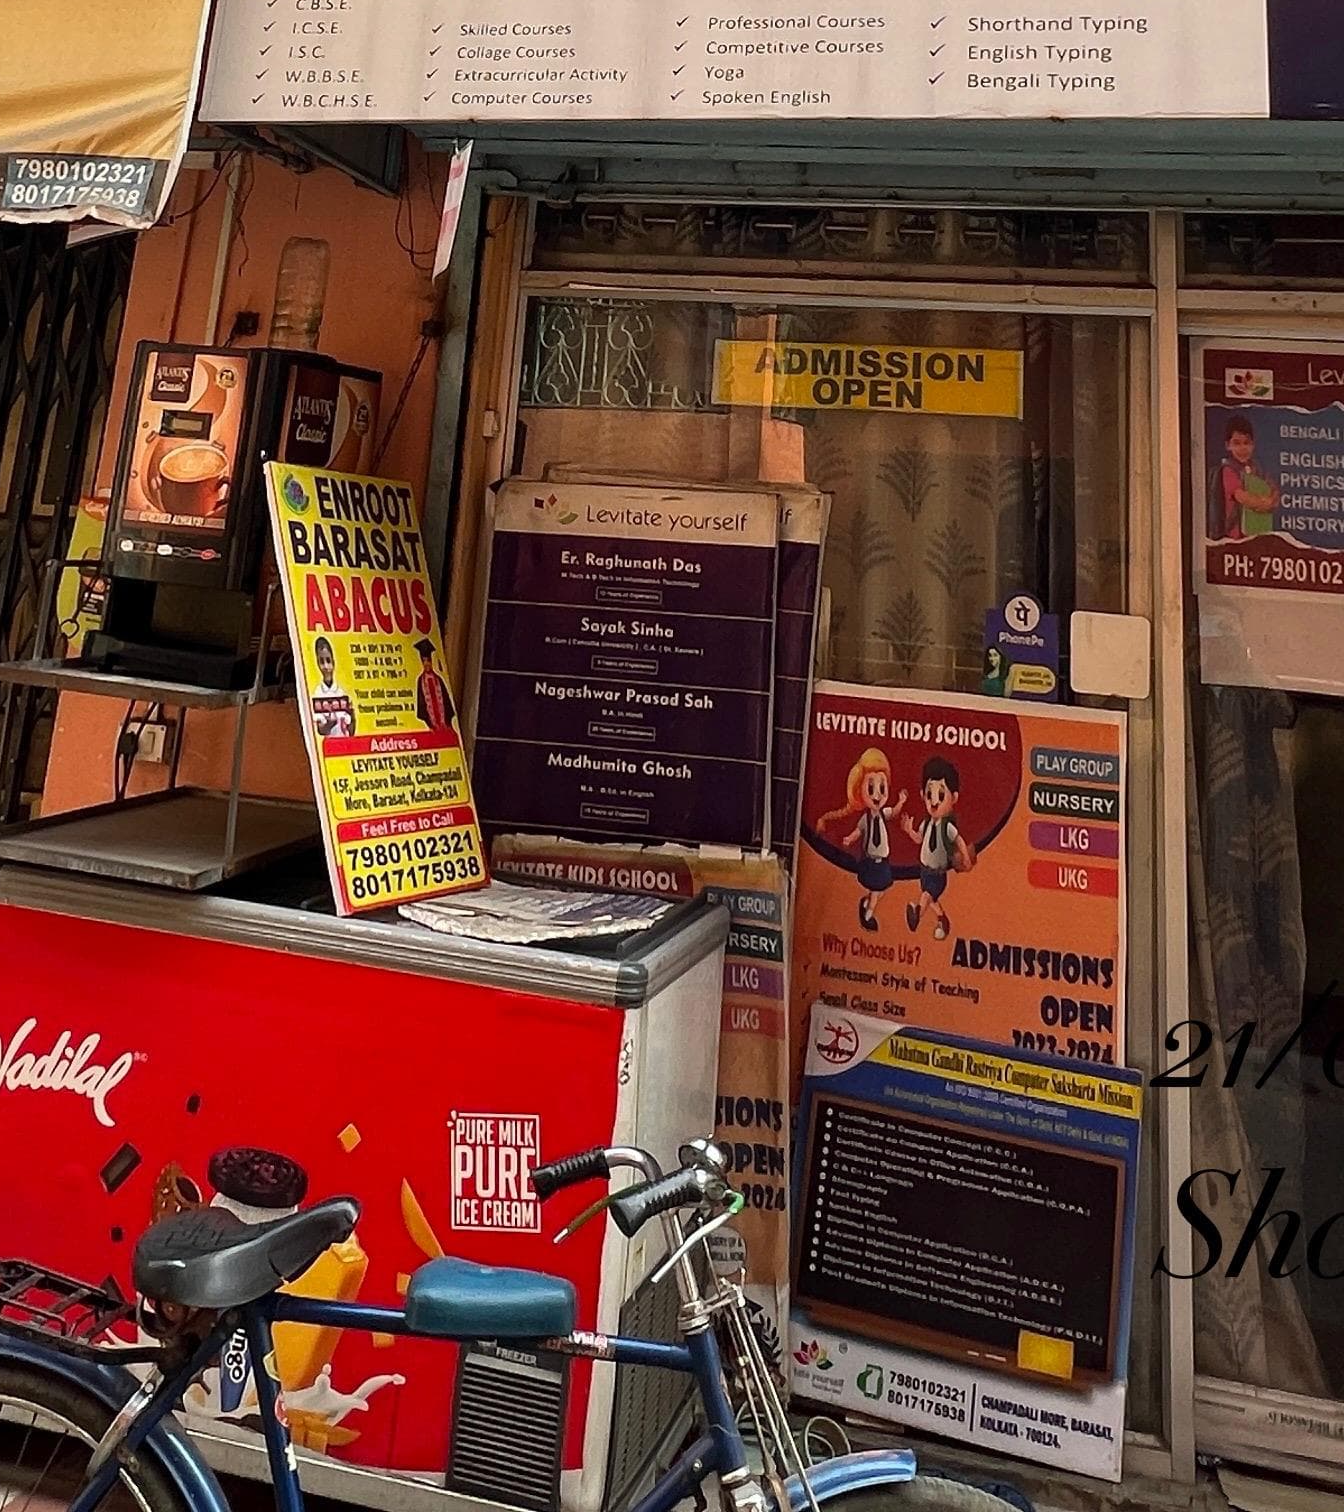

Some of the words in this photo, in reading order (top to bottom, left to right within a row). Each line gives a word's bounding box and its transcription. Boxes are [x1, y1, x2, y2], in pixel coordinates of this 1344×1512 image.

[460, 23, 508, 36] Skilled
[512, 23, 572, 35] Courses
[708, 16, 811, 31] Professional
[816, 14, 886, 30] Courses
[968, 16, 1072, 32] Shorthand
[1080, 16, 1148, 34] Typing
[457, 46, 511, 60] Collage
[516, 46, 576, 59] Courses
[706, 39, 810, 58] Competitive
[814, 40, 884, 54] Courses
[968, 45, 1038, 62] English
[1044, 46, 1112, 63] Typing
[455, 69, 564, 82] Extracurricular
[569, 69, 628, 83] Activity
[704, 66, 744, 82] Yoga
[967, 73, 1040, 91] Bengali
[1048, 74, 1115, 92] Typing
[451, 92, 526, 106] Computer
[532, 92, 593, 104] Courses
[702, 90, 764, 106] Spoken
[770, 90, 831, 106] English
[15, 159, 146, 184] 7980102321
[11, 184, 140, 208] 8017175938
[755, 348, 984, 382] ADMISSION
[812, 379, 923, 409] OPEN
[1280, 425, 1339, 440] BENGALI
[317, 476, 412, 528] ENROOT
[288, 521, 422, 574] BARASAT
[561, 552, 580, 565] Er.
[586, 554, 667, 572] Raghunath
[673, 559, 701, 574] Das
[1224, 555, 1254, 577] PH:
[305, 573, 433, 634] ABACUS
[581, 618, 626, 636] Sayak
[631, 621, 674, 638] Sinha
[999, 632, 1044, 647] PhonePe
[535, 682, 620, 703] Nageshwar
[626, 689, 678, 707] Prasad
[684, 693, 713, 709] Sah
[816, 711, 886, 737] LEVITATE
[891, 721, 931, 743] KIDS
[936, 725, 1006, 751] SCHOOL
[370, 738, 417, 751] Address
[548, 752, 636, 774] Madhumita
[642, 761, 692, 779] Ghosh
[1036, 754, 1066, 772] PLAY
[1070, 758, 1113, 778] GROUP
[1033, 789, 1115, 814] NURSERY
[347, 830, 474, 870] 7980102321
[352, 856, 480, 899] 8017175938
[951, 938, 1113, 989] ADMISSIONS
[1040, 996, 1113, 1033] OPEN
[456, 1119, 495, 1145] PURE
[499, 1120, 534, 1146] MILK
[456, 1145, 537, 1200] PURE
[456, 1199, 478, 1225] ICE
[483, 1200, 534, 1227] CREAM
[496, 1347, 537, 1366] FREEZER
[889, 1371, 966, 1403] 7980102321
[888, 1390, 965, 1422] 8017175938
